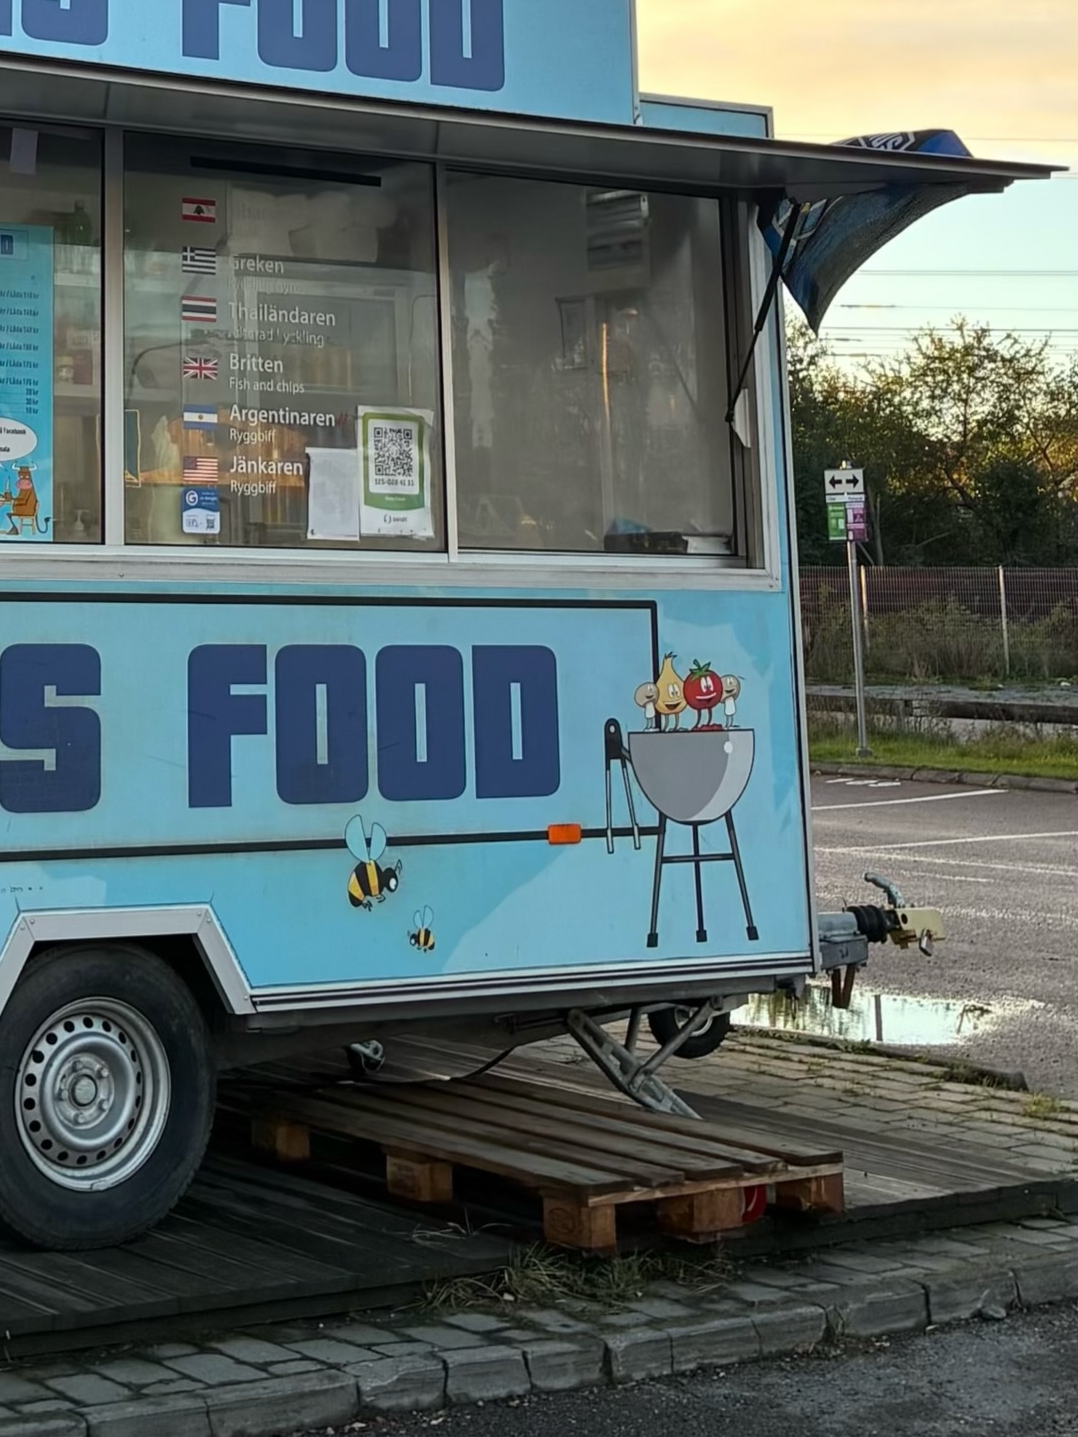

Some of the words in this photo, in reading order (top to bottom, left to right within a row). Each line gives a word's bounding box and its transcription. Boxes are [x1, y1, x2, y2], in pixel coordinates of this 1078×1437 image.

[228, 302, 336, 326] Thailändaren
[229, 353, 283, 373] Britten
[229, 377, 250, 390] Fish
[253, 379, 274, 392] and
[276, 380, 305, 395] chips
[229, 404, 336, 427] Argentinaren
[229, 428, 277, 444] Ryggbiff
[229, 455, 303, 476] Jänkaren
[230, 479, 277, 496] Ryggbiff
[187, 643, 561, 809] FOOD
